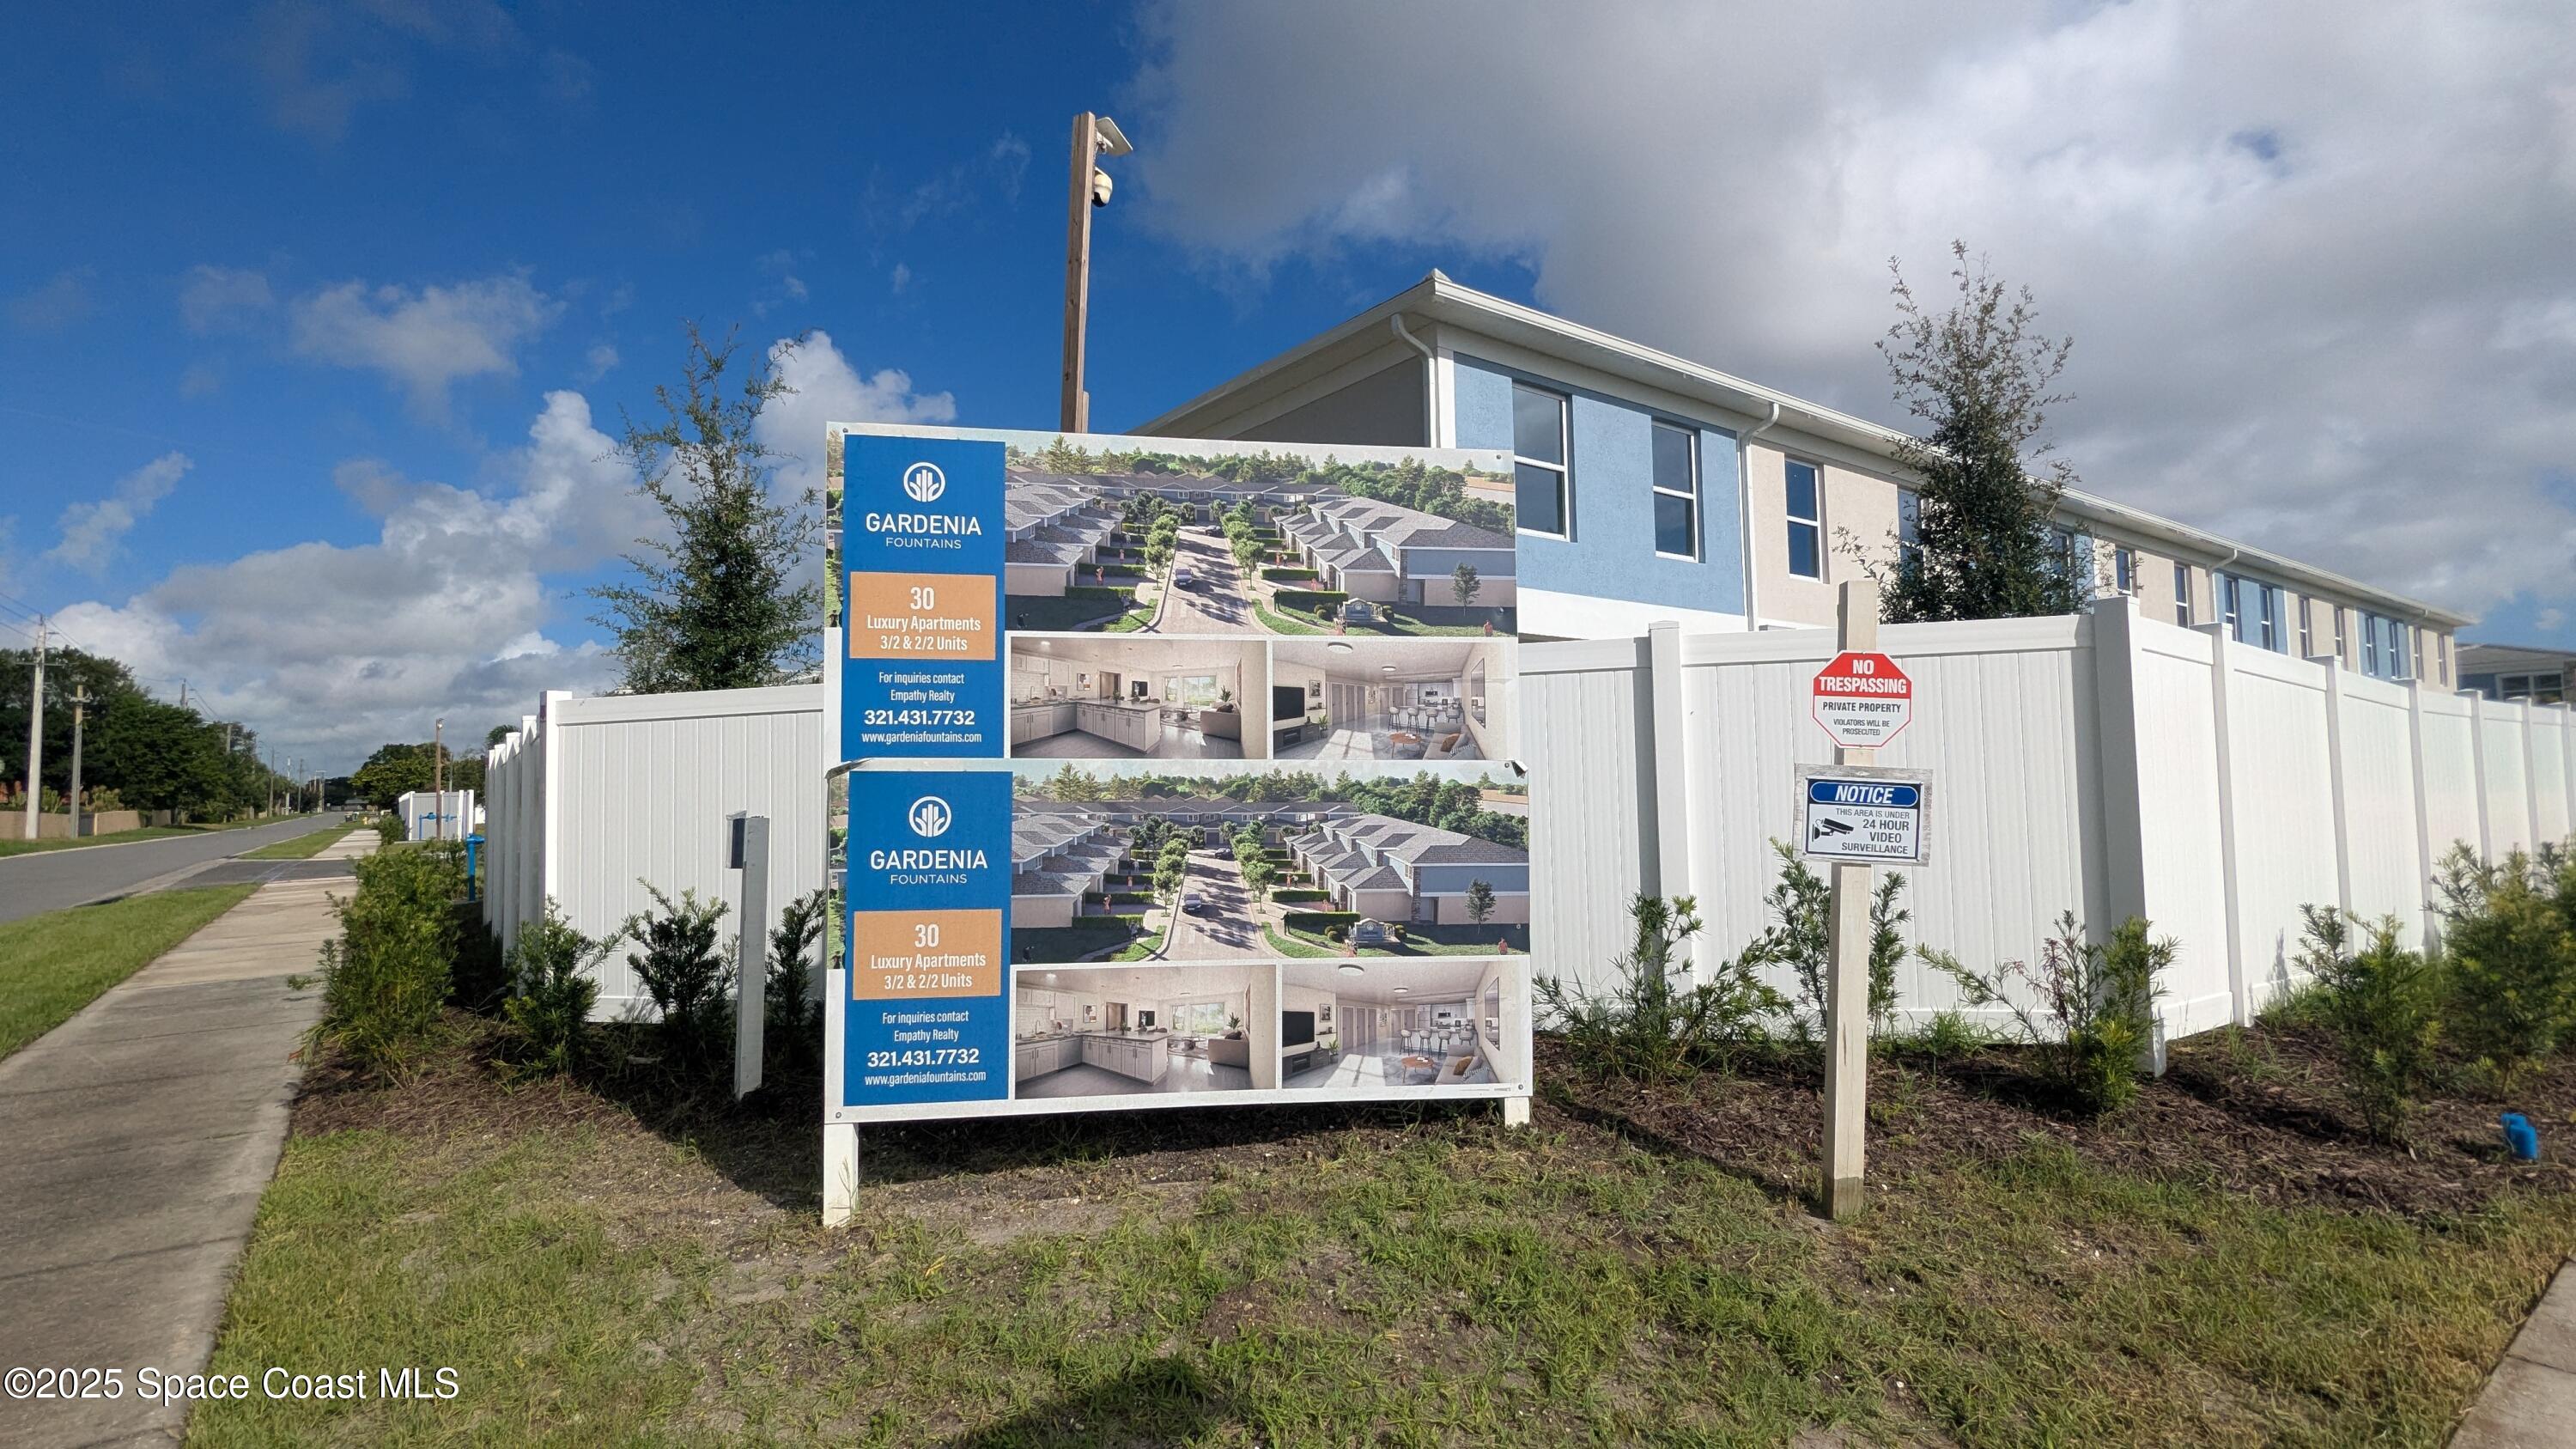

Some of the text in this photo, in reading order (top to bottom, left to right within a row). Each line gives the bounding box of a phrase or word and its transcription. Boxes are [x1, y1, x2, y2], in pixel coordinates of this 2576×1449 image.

[866, 513, 981, 536] GARDENIA
[885, 538, 962, 549] FOUNTAINS
[910, 587, 934, 611] 30
[867, 615, 981, 633] Luxury Apartments
[880, 636, 968, 651] 3/2 & 2/2 Units
[1853, 660, 1874, 675] NO
[878, 672, 964, 685] For inquiries contact
[1820, 676, 1907, 694] TRESPASSING
[890, 690, 955, 703] Empathy Realty
[1823, 702, 1901, 713] PRIVATE PROPERTY
[864, 709, 975, 726] 321.431.7732
[1834, 718, 1865, 727] VIOLATORS
[861, 731, 981, 745] www.gardeniafountains.com
[1843, 728, 1880, 736] PROSECUTED
[1835, 785, 1893, 804] NOTICE
[1854, 808, 1874, 817] AREA
[1862, 819, 1909, 831] 24 HOUR
[1869, 832, 1901, 843] VIDEO
[1842, 843, 1908, 854] SURVEILLANCE
[871, 849, 987, 870] GARDENIA
[890, 874, 968, 885] FOUNTAINS
[914, 924, 939, 947] 30
[871, 953, 986, 971] Luxury Apartments
[884, 973, 972, 989] 3/2 & 2/2 Units
[883, 1011, 969, 1026] For inquiries contact
[894, 1029, 959, 1043] Empathy Realty
[867, 1049, 979, 1067] 321.431.7732
[865, 1070, 986, 1087] www.gardeniafountains.com
